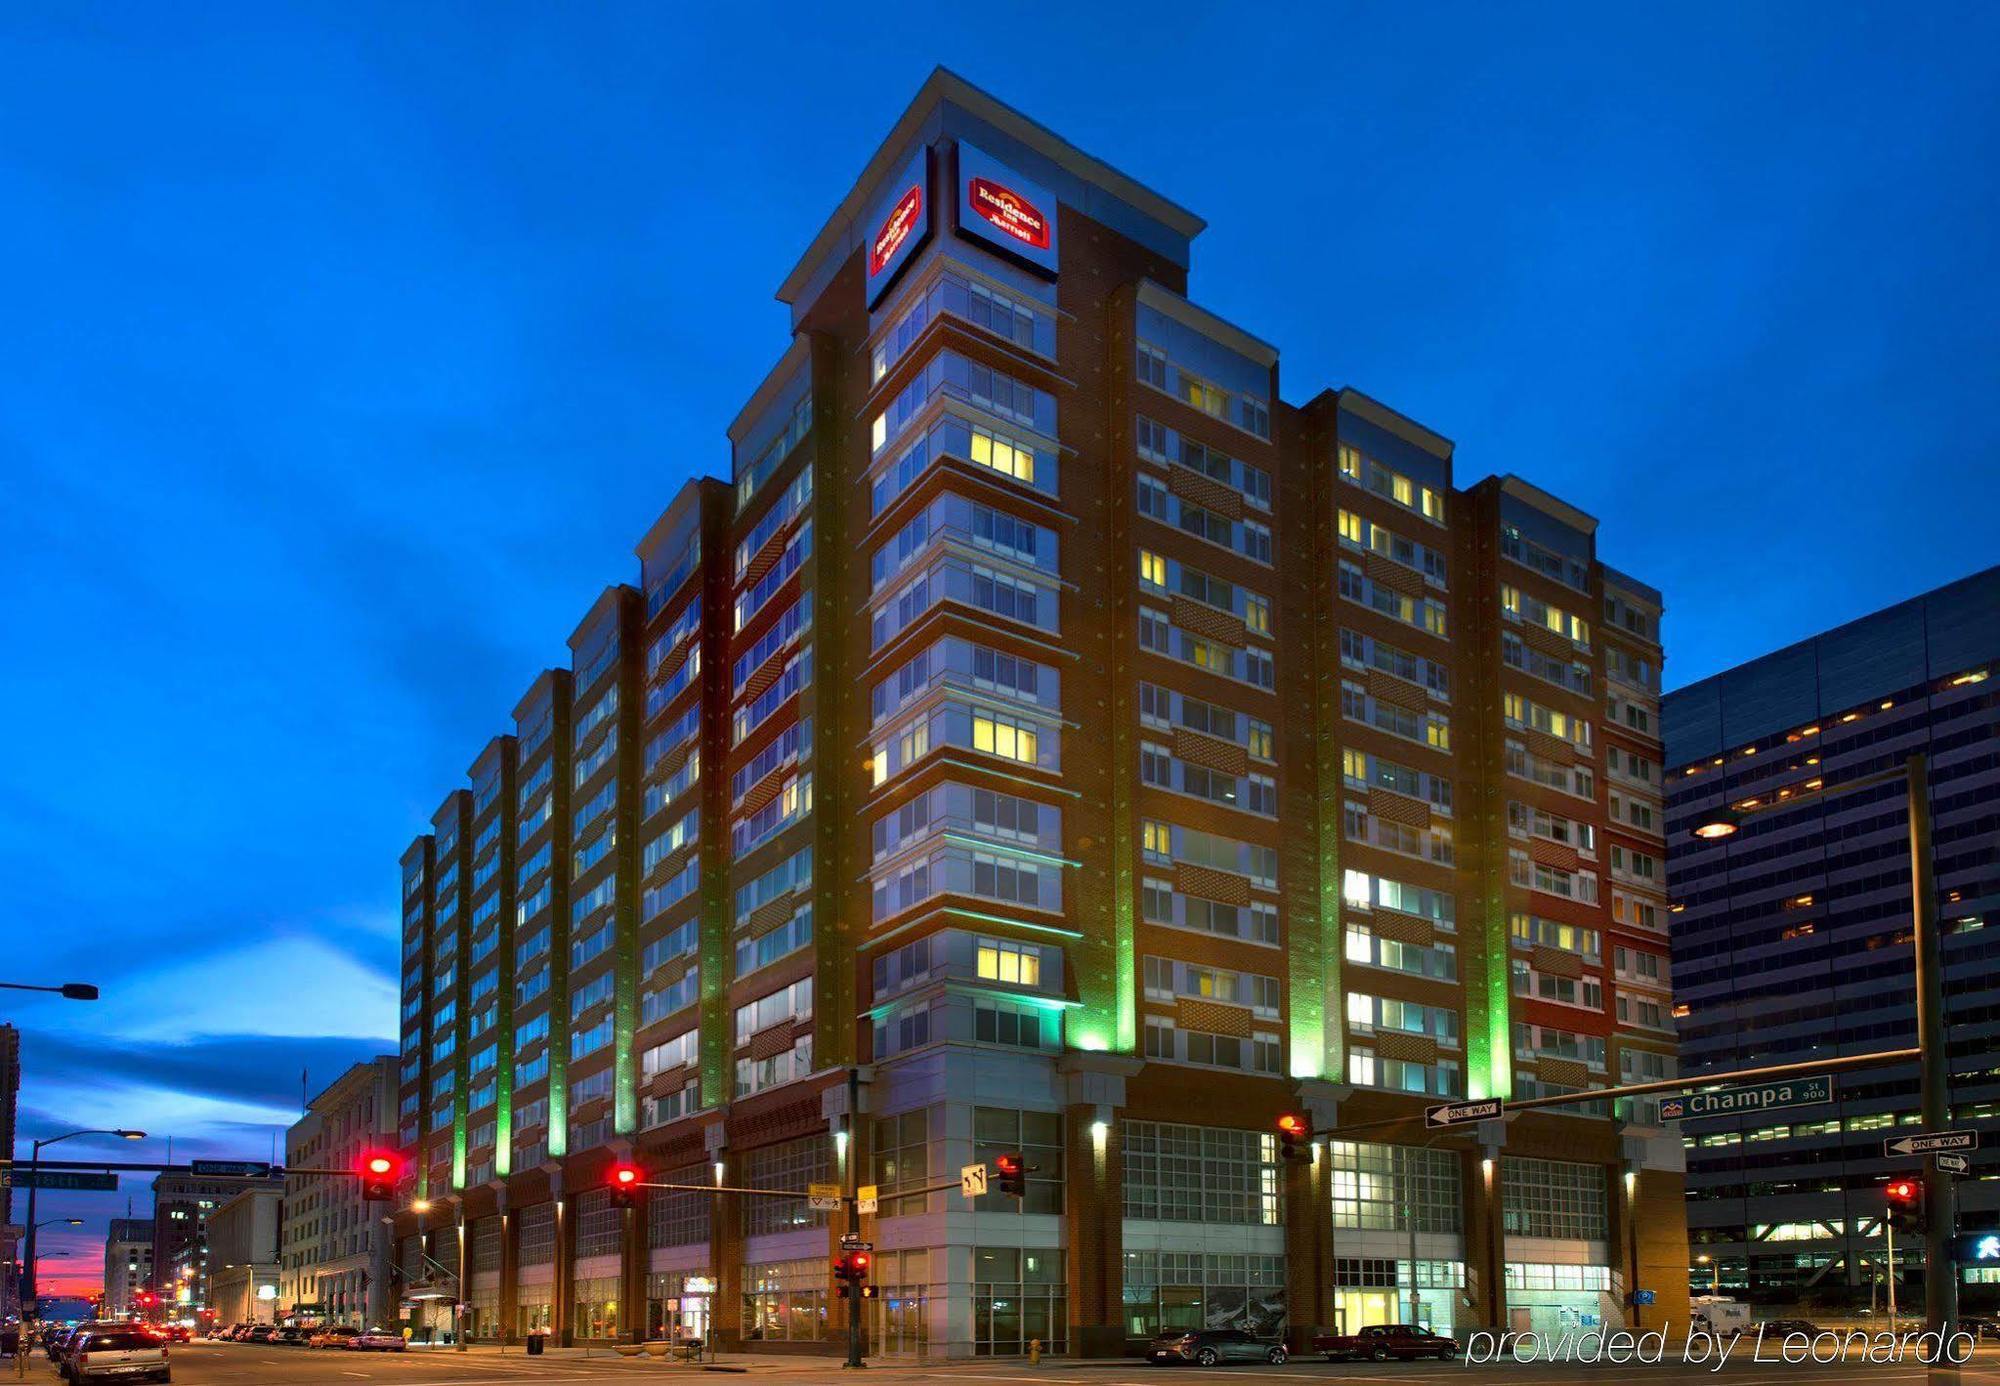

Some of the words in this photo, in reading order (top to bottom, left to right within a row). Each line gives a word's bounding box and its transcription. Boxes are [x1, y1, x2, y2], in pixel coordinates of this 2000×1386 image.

[979, 186, 1041, 230] Residence
[1808, 1082, 1819, 1091] St
[1690, 1086, 1793, 1112] Champa
[1803, 1090, 1825, 1100] 900
[1448, 1109, 1469, 1118] ONE
[1471, 1105, 1492, 1114] WAY
[1912, 1141, 1934, 1149] ONE
[1940, 1137, 1965, 1145] WAY
